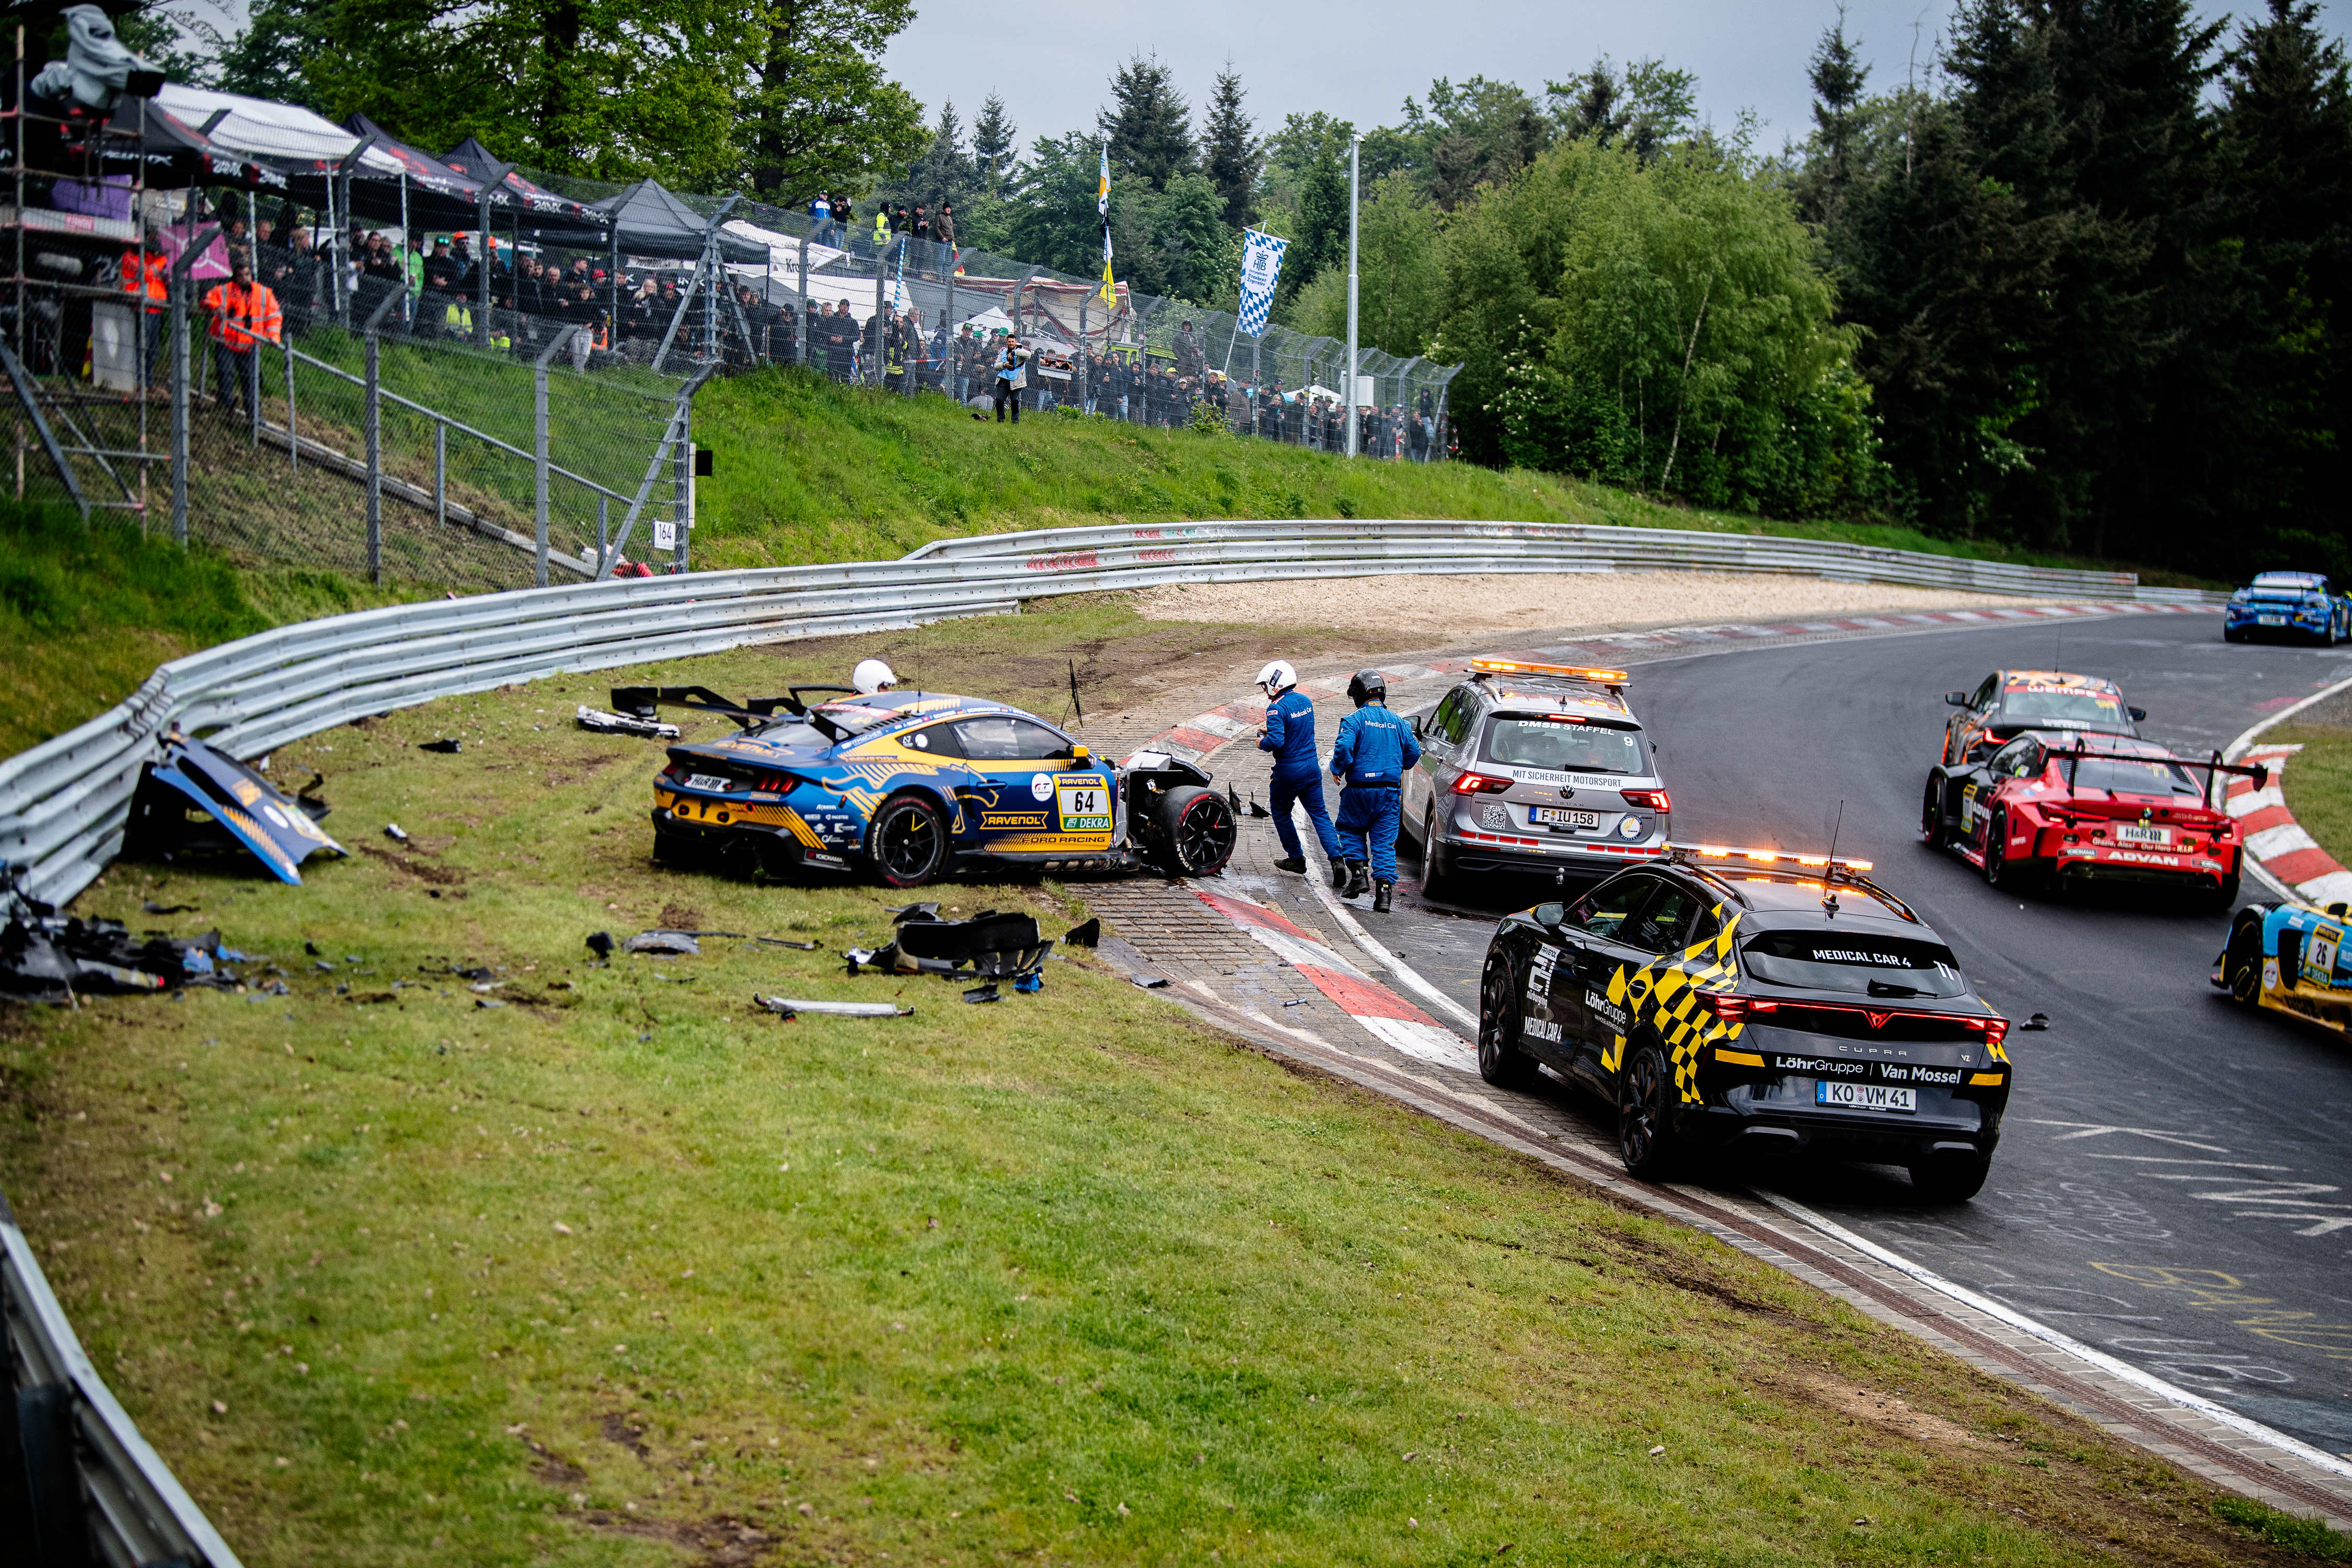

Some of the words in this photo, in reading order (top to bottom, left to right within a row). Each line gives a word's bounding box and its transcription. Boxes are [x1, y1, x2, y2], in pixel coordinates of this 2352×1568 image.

[659, 523, 672, 541] 164
[1290, 709, 1307, 719] Medical
[1365, 720, 1387, 729] Medical
[1518, 720, 1561, 729] DMSB
[1563, 723, 1615, 735] STAFFEL
[1623, 736, 1634, 747] 9
[1513, 770, 1526, 779] MIT
[1528, 771, 1571, 783] SICHERHEIT
[1573, 776, 1623, 788] MOTORSPORT.
[1075, 791, 1094, 812] 64
[988, 816, 1041, 825] RAVENOL
[1079, 817, 1109, 828] DEKRA
[1542, 810, 1550, 821] F
[1557, 811, 1571, 824] IU
[1573, 812, 1594, 825] 158
[815, 853, 843, 863] YOKOHAMA
[1176, 843, 1194, 871] ADVAN
[2108, 851, 2179, 867] ADVAN
[1541, 946, 1557, 959] RAVENOL
[1813, 950, 1873, 962] MEDICAL
[1873, 953, 1901, 966] CAR
[1903, 958, 1911, 967] 4
[2316, 942, 2327, 966] 26
[1526, 989, 1548, 1009] nürburgring
[1585, 989, 1626, 1024] LöhrGruppe
[1524, 1016, 1546, 1040] MEDICAL
[1546, 1021, 1558, 1042] CAR
[1557, 1025, 1562, 1043] 4
[1839, 1046, 1907, 1056] CUPRA
[1776, 1056, 1863, 1075] LöhrGruppe
[1881, 1064, 1907, 1079] Van
[1911, 1066, 1962, 1085] Mossel
[1832, 1084, 1854, 1102] KO
[1865, 1087, 1886, 1105] VM
[1890, 1090, 1909, 1107] 41
